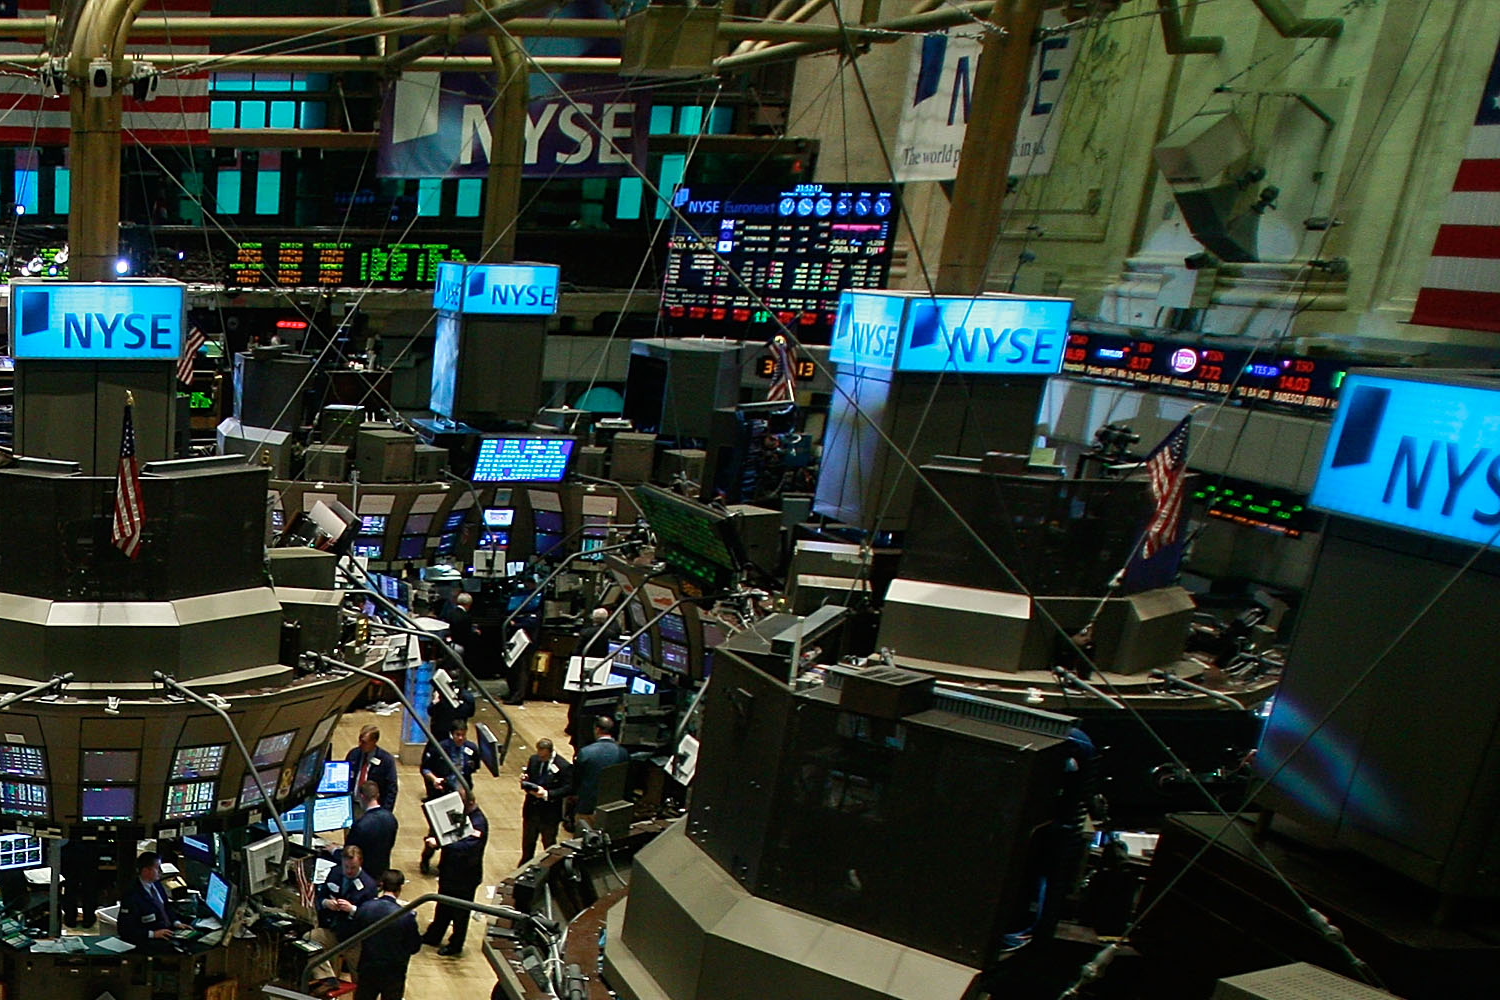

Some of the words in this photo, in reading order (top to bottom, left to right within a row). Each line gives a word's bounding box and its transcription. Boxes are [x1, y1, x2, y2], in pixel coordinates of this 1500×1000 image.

[688, 201, 720, 213] NYSE
[723, 201, 776, 213] Euronext
[492, 284, 554, 306] NYSE
[63, 312, 172, 350] NYSE
[850, 321, 898, 359] NYSE
[950, 326, 1057, 365] NYSE
[1382, 435, 1500, 526] NYS
